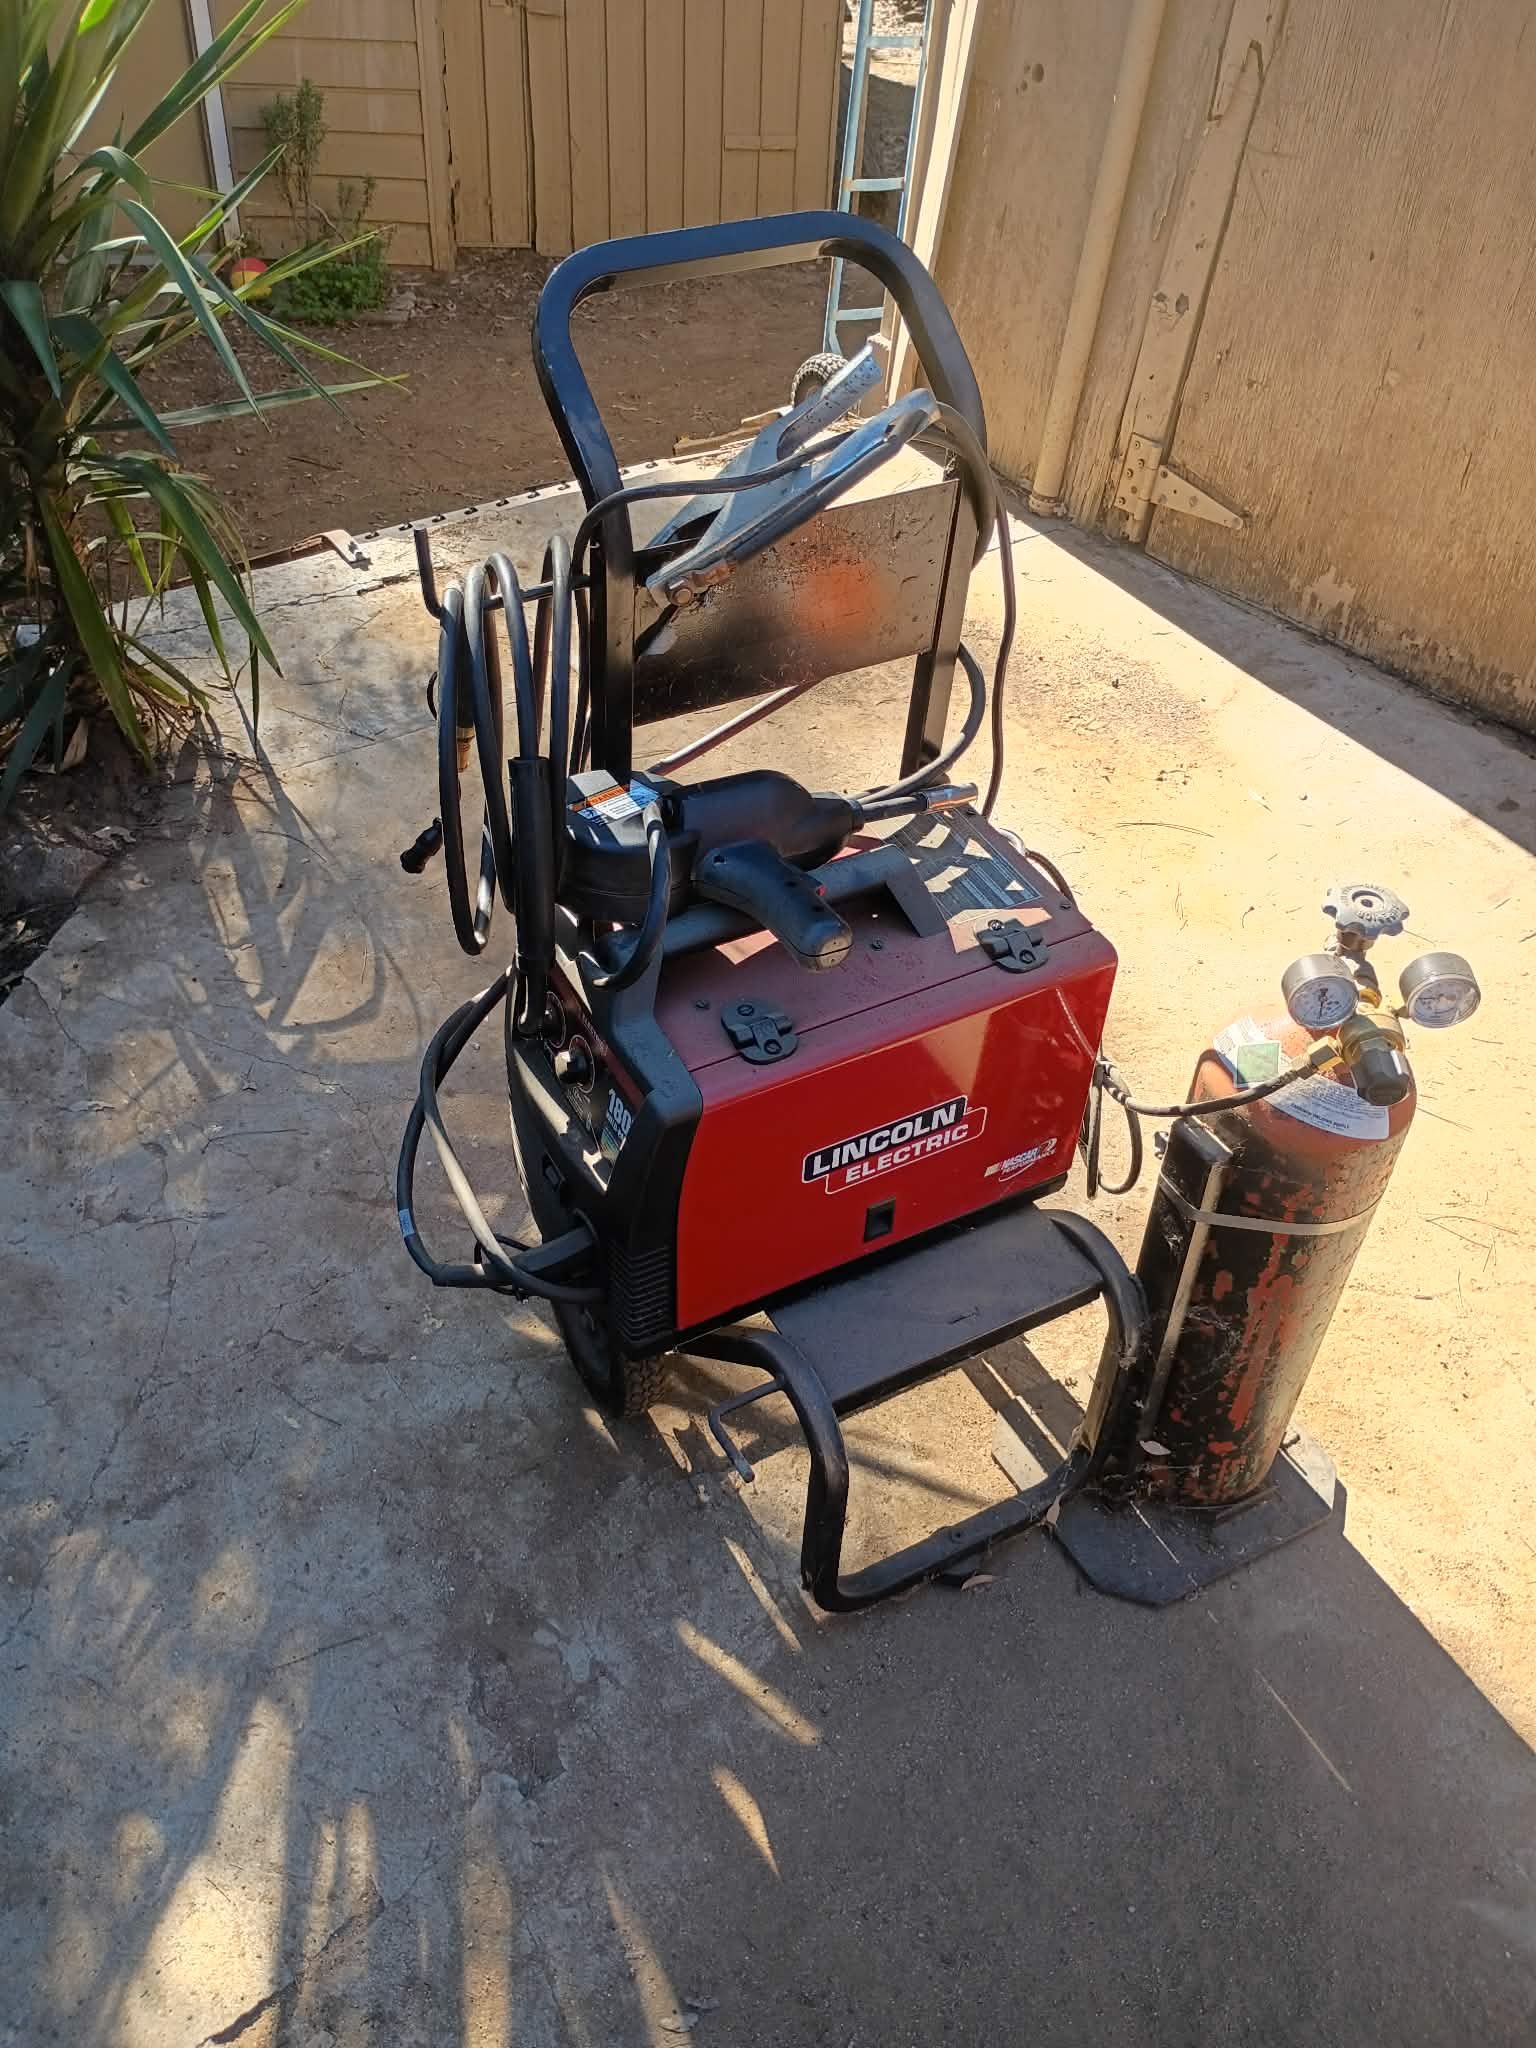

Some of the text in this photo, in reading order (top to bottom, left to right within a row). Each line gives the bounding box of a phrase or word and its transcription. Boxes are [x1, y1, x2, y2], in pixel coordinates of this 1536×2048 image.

[608, 1088, 632, 1136] 180
[812, 1103, 957, 1175] LINCOLN
[845, 1124, 969, 1183] ELECTRIC
